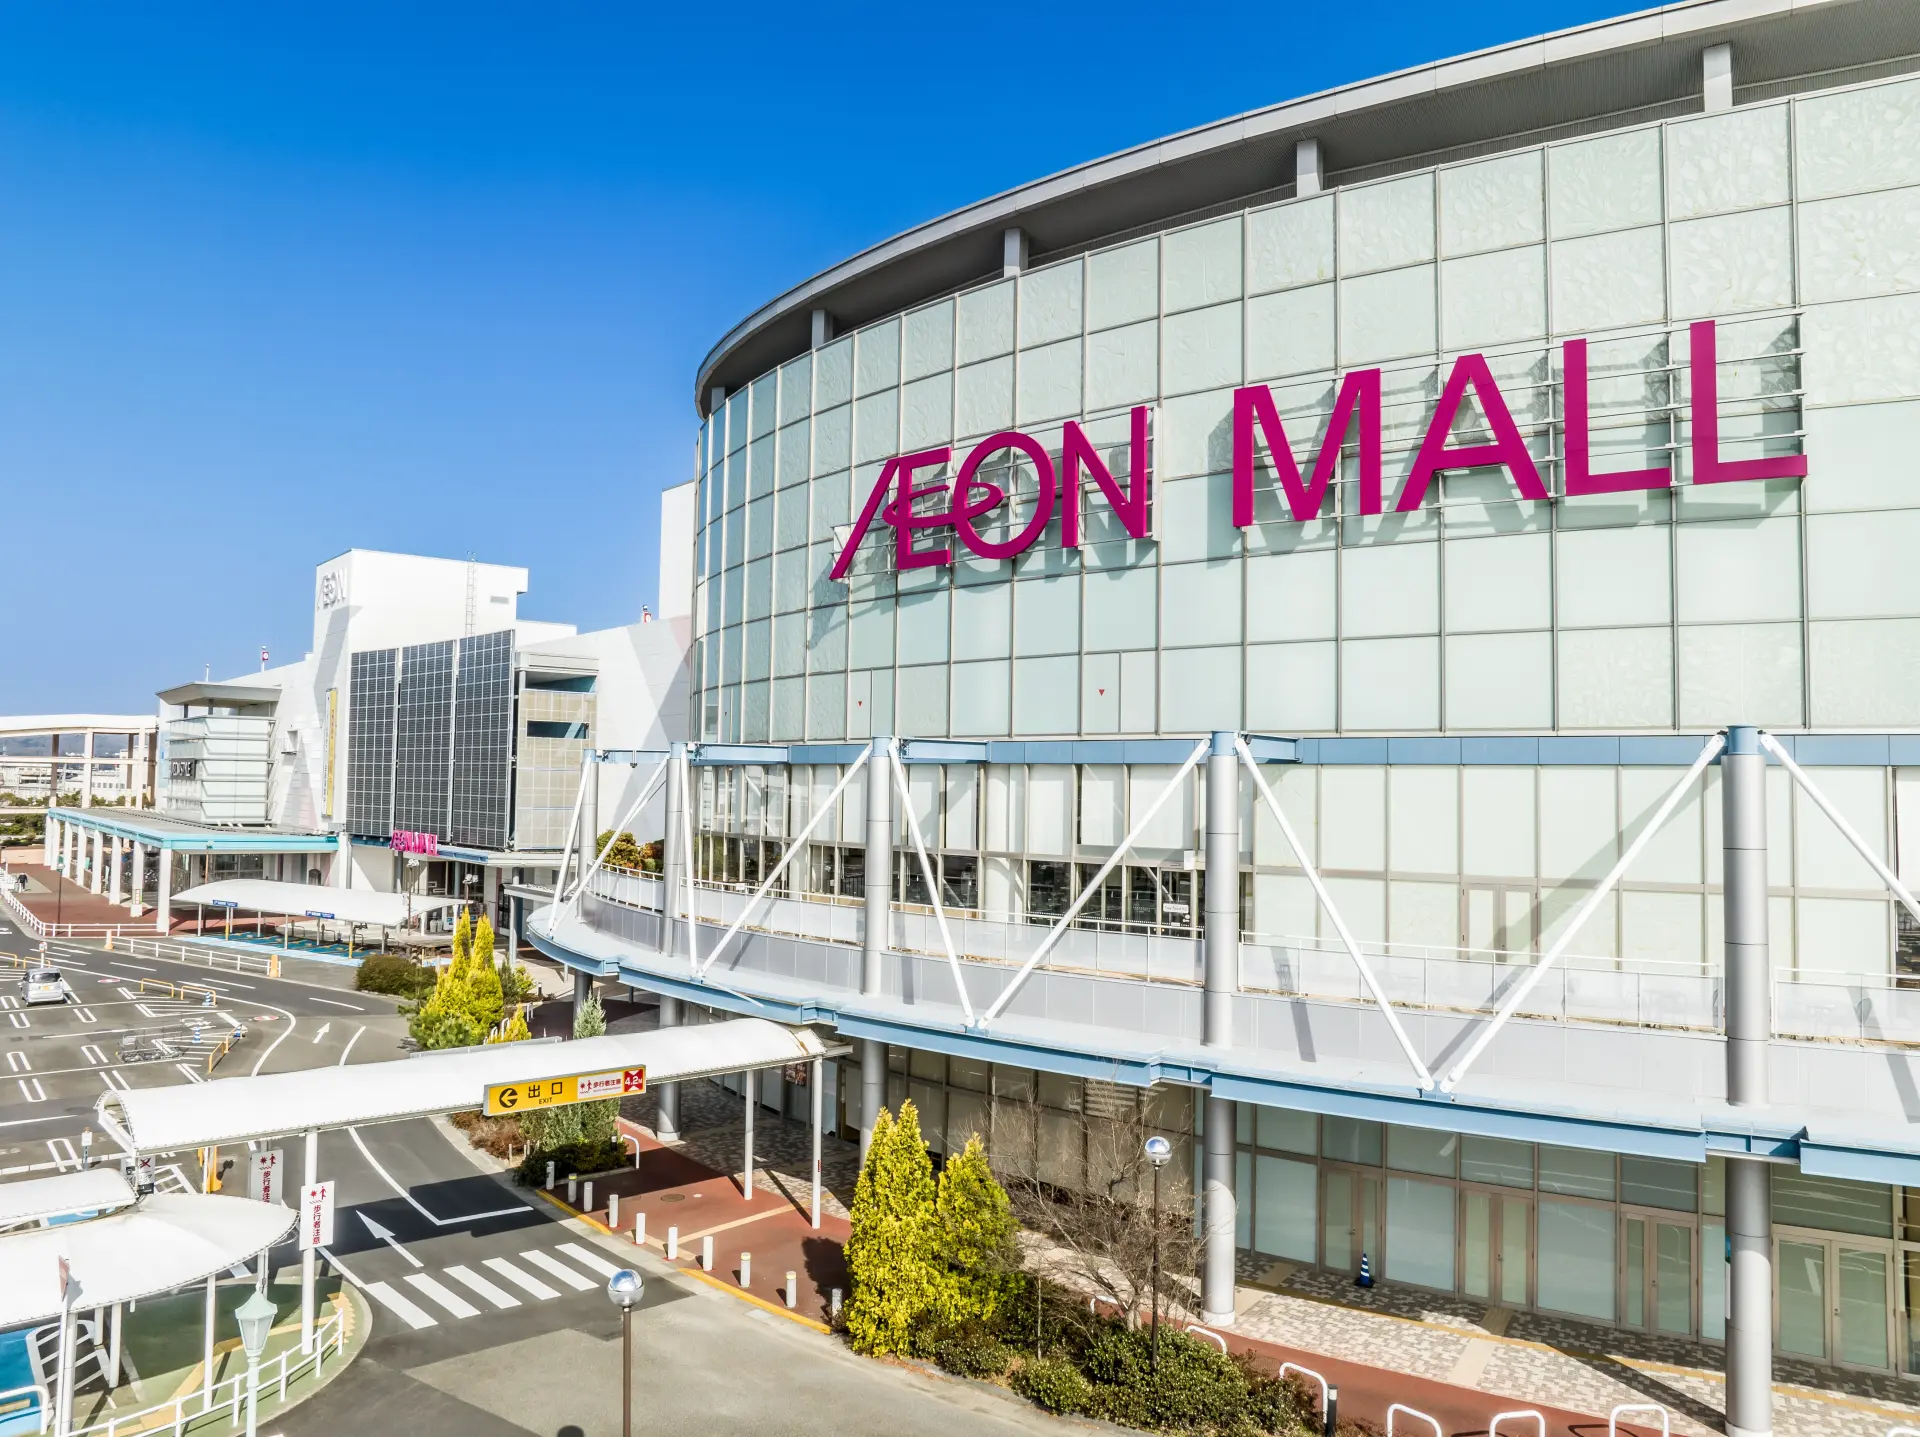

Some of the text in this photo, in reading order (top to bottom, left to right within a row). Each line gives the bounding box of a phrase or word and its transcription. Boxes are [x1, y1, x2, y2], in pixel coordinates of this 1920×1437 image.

[1233, 320, 1808, 527] MALL
[538, 1097, 553, 1105] EXIT
[262, 1170, 271, 1203] 歩行者注
[312, 1204, 322, 1245] 歩行者注意
